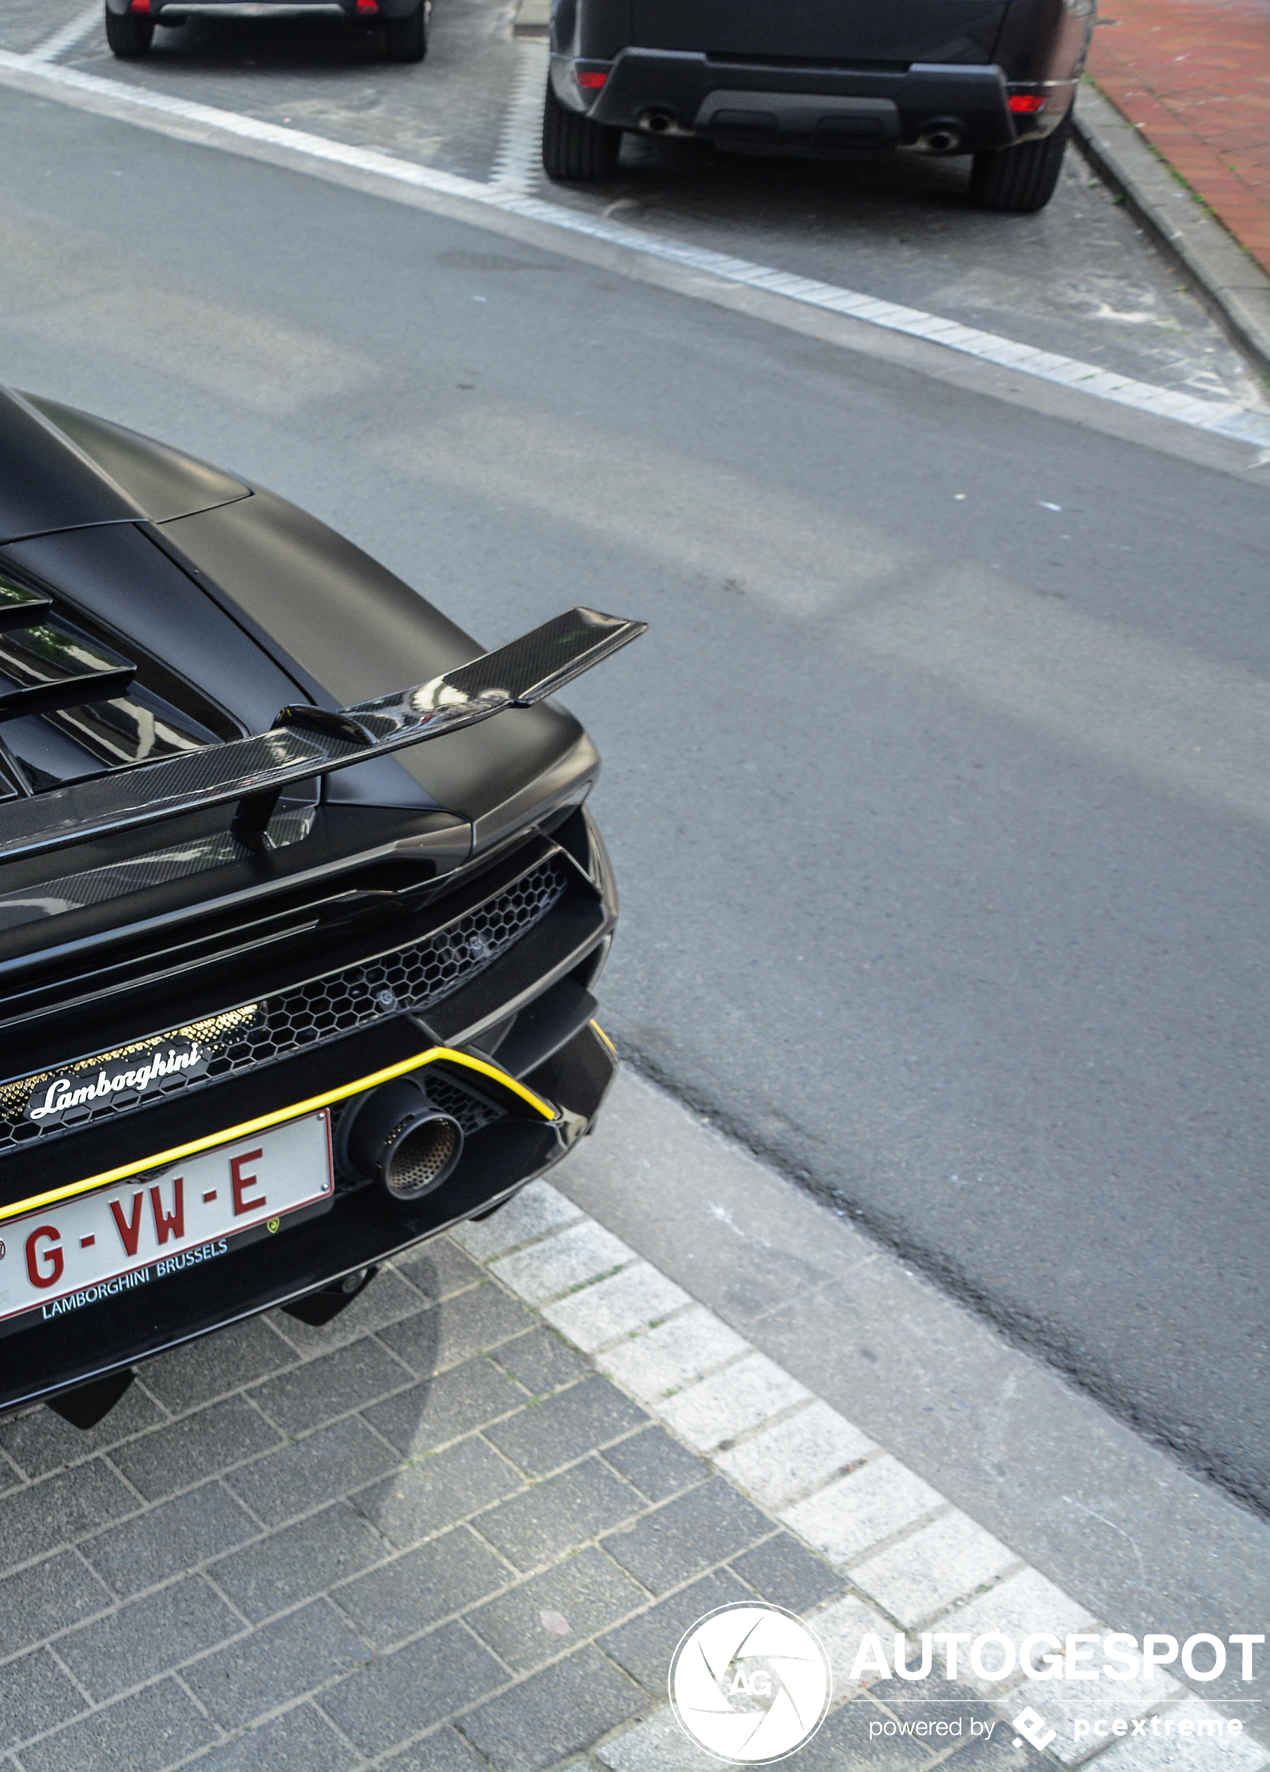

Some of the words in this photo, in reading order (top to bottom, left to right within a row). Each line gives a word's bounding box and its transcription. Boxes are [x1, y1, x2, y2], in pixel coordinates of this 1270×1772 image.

[30, 1041, 201, 1120] Lamborghini
[42, 1267, 151, 1320] LAMBORGHINI
[156, 1238, 228, 1278] BRUSSELS
